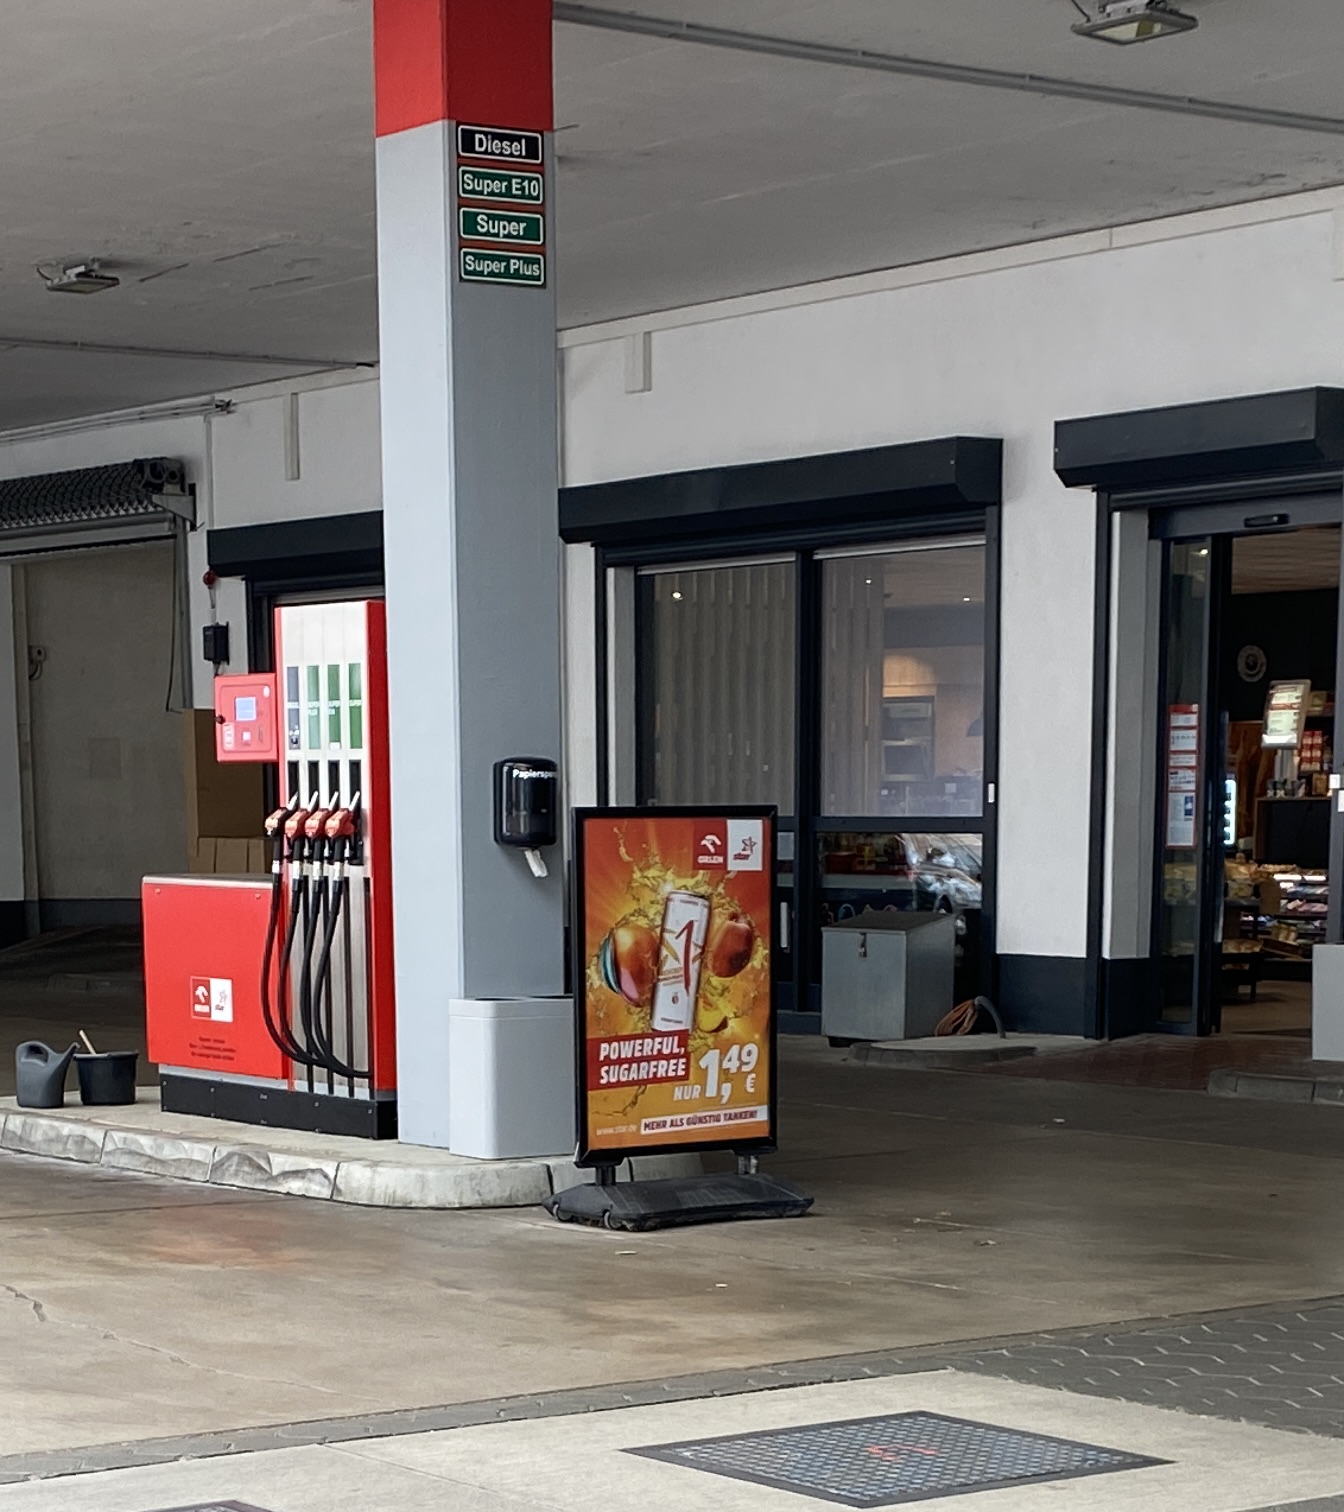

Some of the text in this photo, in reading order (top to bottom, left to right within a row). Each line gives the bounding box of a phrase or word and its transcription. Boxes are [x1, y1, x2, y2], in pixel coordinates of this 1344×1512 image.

[475, 133, 526, 157] Diesel
[463, 173, 539, 196] Super E10
[476, 214, 526, 238] Super
[465, 255, 540, 276] Super Plus
[599, 1036, 685, 1061] POWERFUL,
[599, 1058, 686, 1084] SUGARFREE
[673, 1084, 702, 1101] NUR
[643, 1119, 667, 1132] MEHR
[669, 1117, 685, 1128] ALS
[686, 1113, 722, 1126] GÜNSTIG
